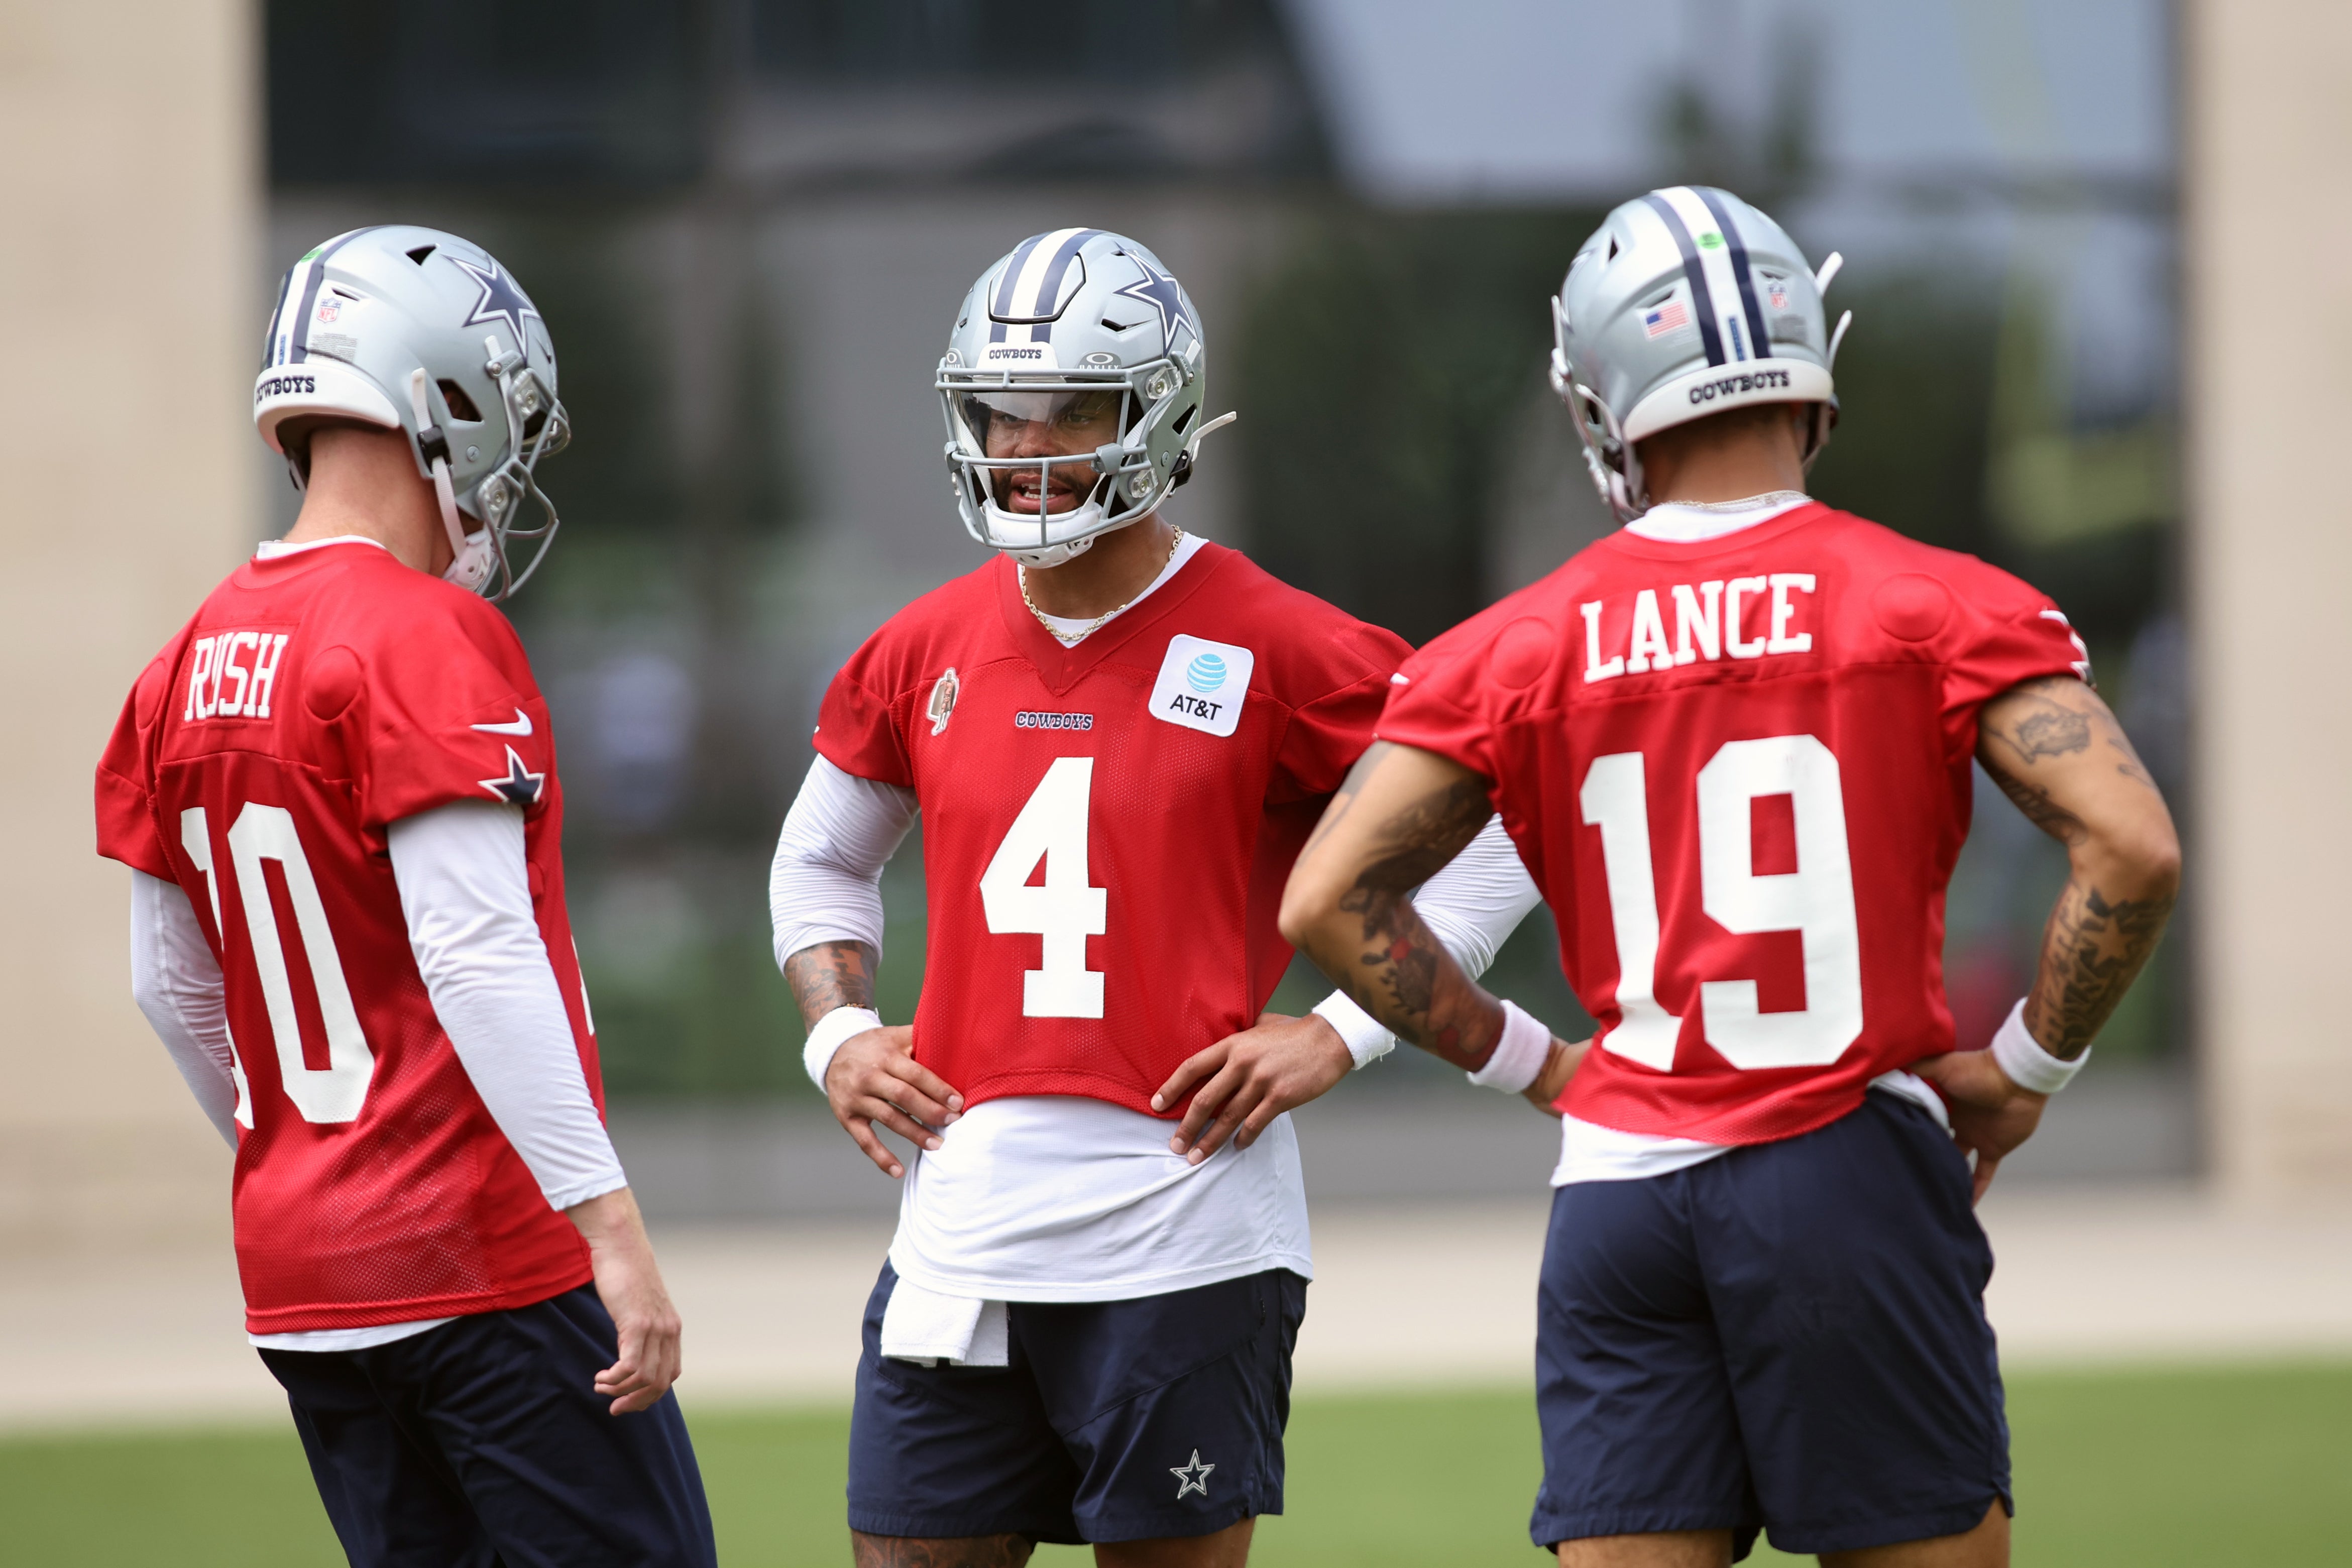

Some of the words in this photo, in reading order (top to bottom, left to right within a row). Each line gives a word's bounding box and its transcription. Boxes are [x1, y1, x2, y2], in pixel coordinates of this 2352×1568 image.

[318, 307, 336, 321] NFL
[988, 349, 1042, 360] COWBOYS
[1689, 370, 1790, 404] COWBOYS
[1580, 573, 1816, 684] LANCE
[1015, 711, 1093, 730] COWBOYS
[1169, 694, 1222, 721] AT&T
[979, 756, 1107, 1019] 4
[1579, 733, 1864, 1073] 19
